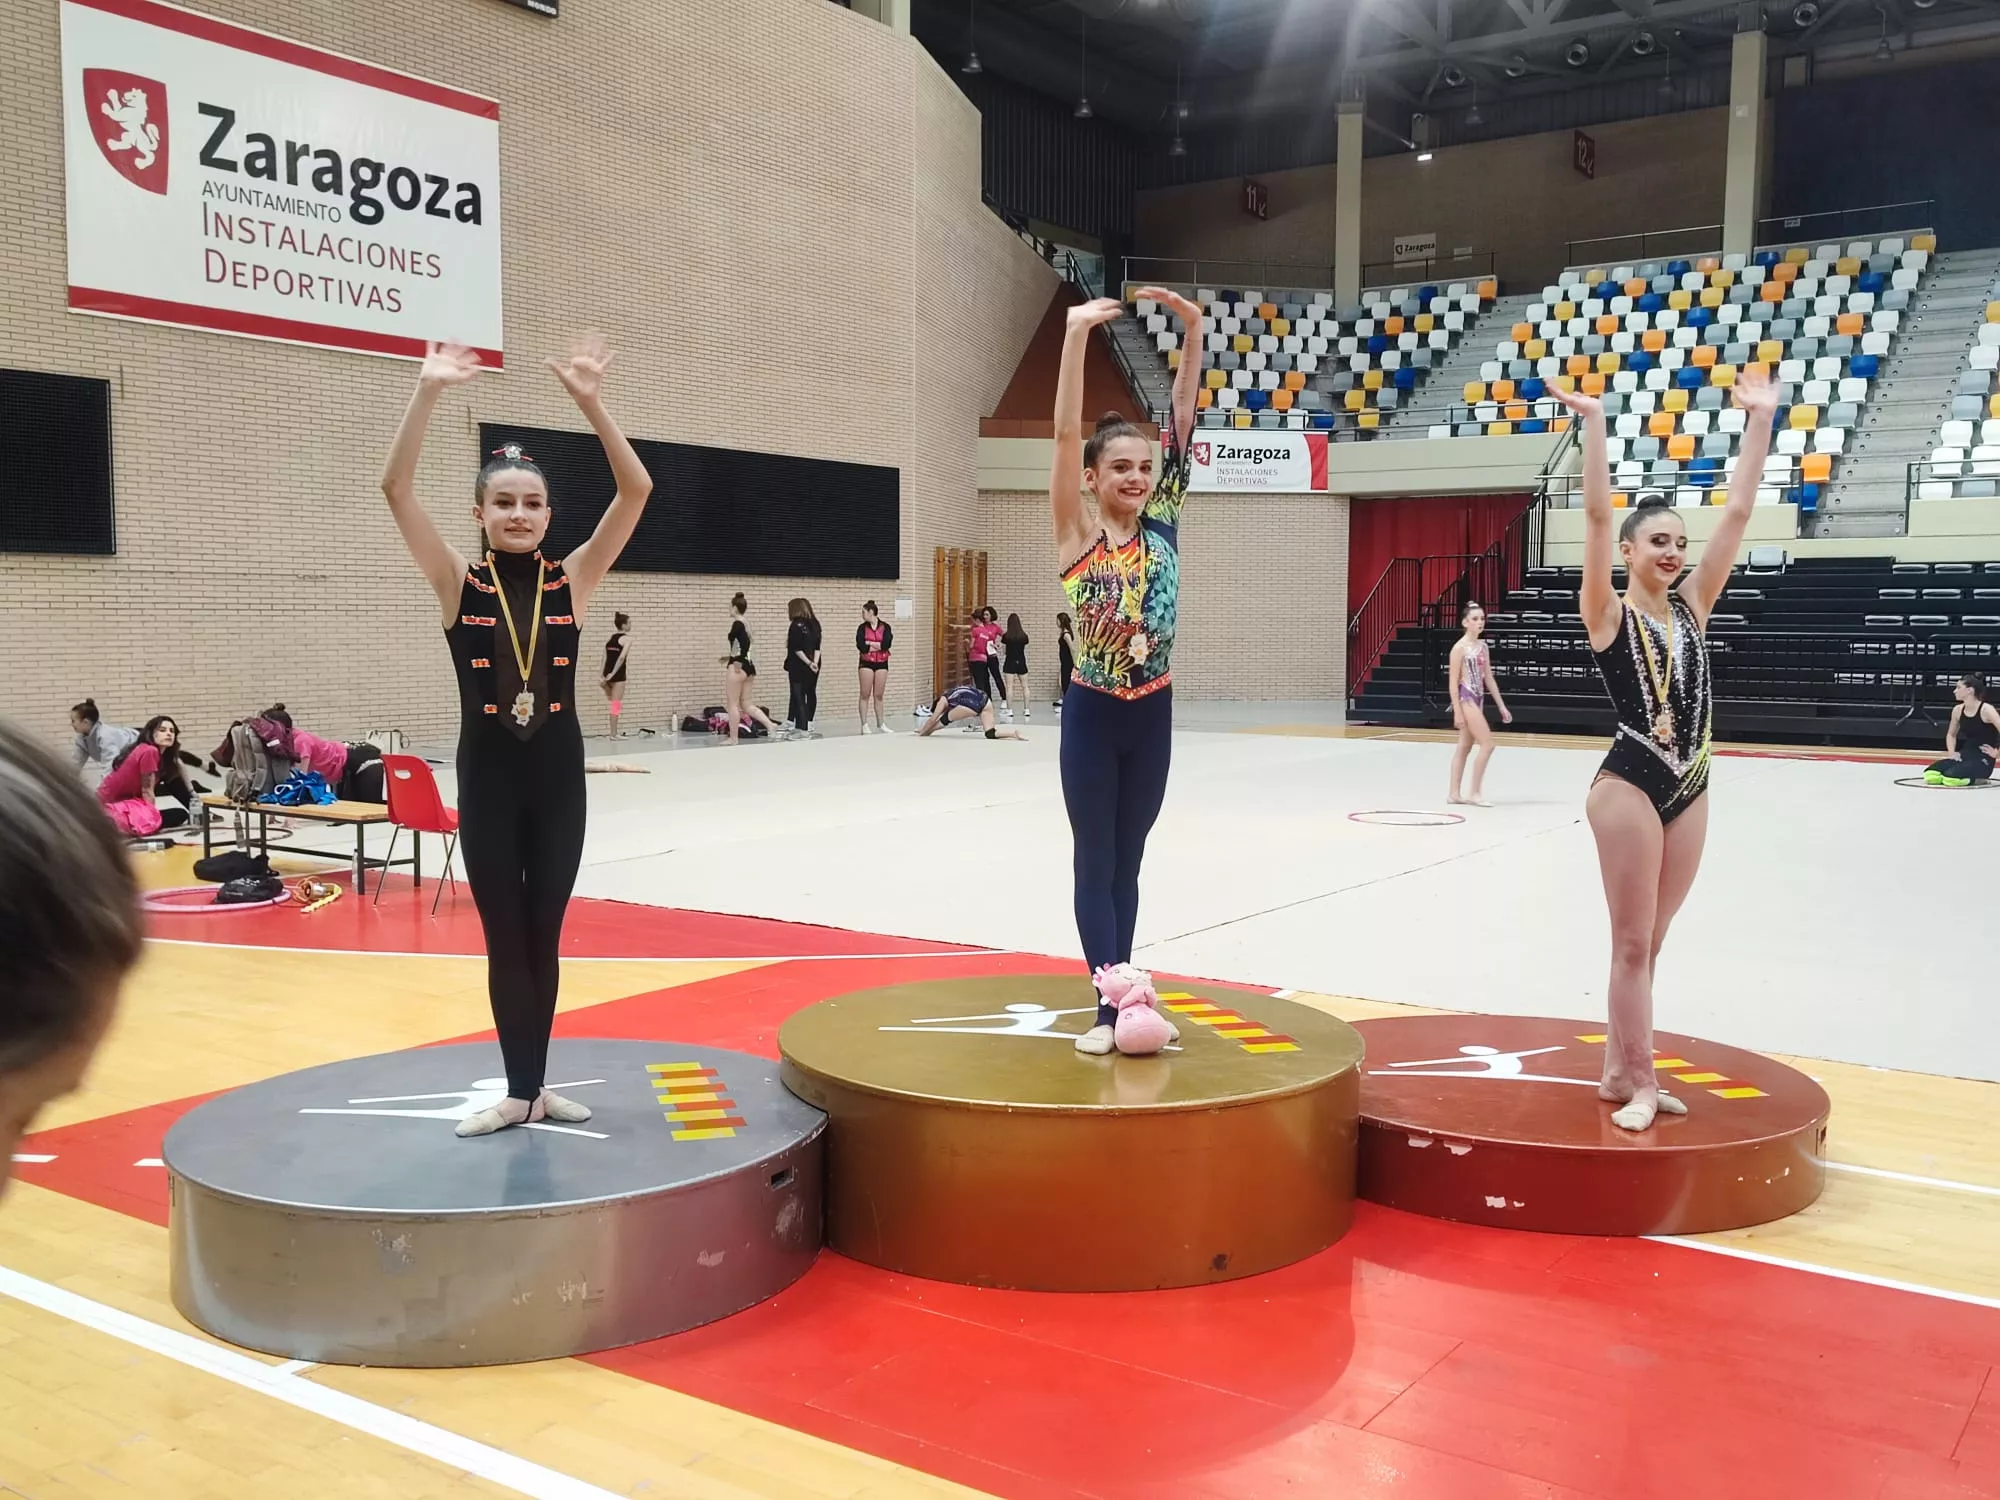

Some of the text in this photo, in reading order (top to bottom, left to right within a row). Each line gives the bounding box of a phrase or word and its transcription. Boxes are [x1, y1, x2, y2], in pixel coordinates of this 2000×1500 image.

[198, 101, 482, 226] Zaragoza
[1577, 137, 1587, 169] 12
[201, 180, 342, 224] AYUNTAMIENTO
[1246, 184, 1257, 212] 11
[1404, 243, 1435, 253] Zaragoza
[1217, 444, 1290, 464] Zaragoza
